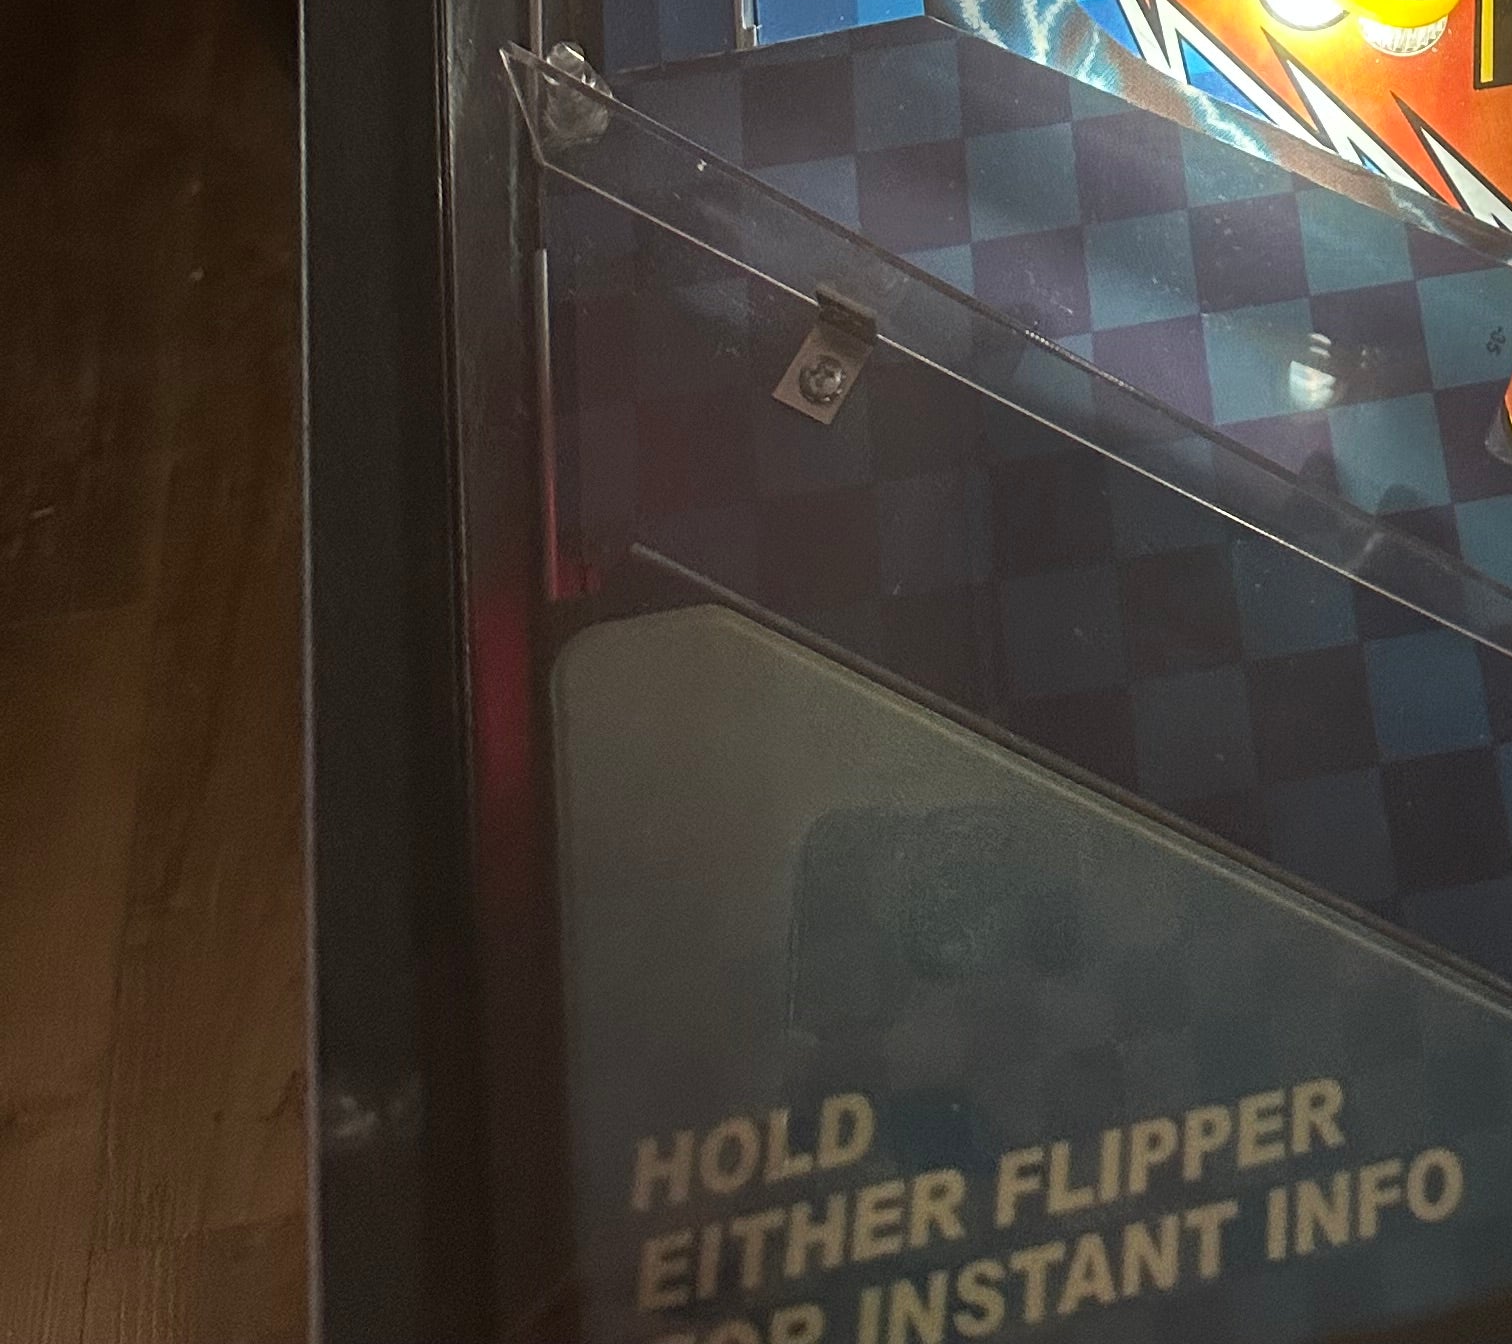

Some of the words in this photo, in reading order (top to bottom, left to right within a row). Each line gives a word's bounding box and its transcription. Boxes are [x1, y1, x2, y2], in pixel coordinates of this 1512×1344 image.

[628, 1091, 876, 1211] HOLD
[636, 1168, 967, 1314] EITHER
[996, 1076, 1347, 1230] FLIPPER
[856, 1198, 1239, 1344] INSTANT
[1264, 1147, 1464, 1265] INFO
